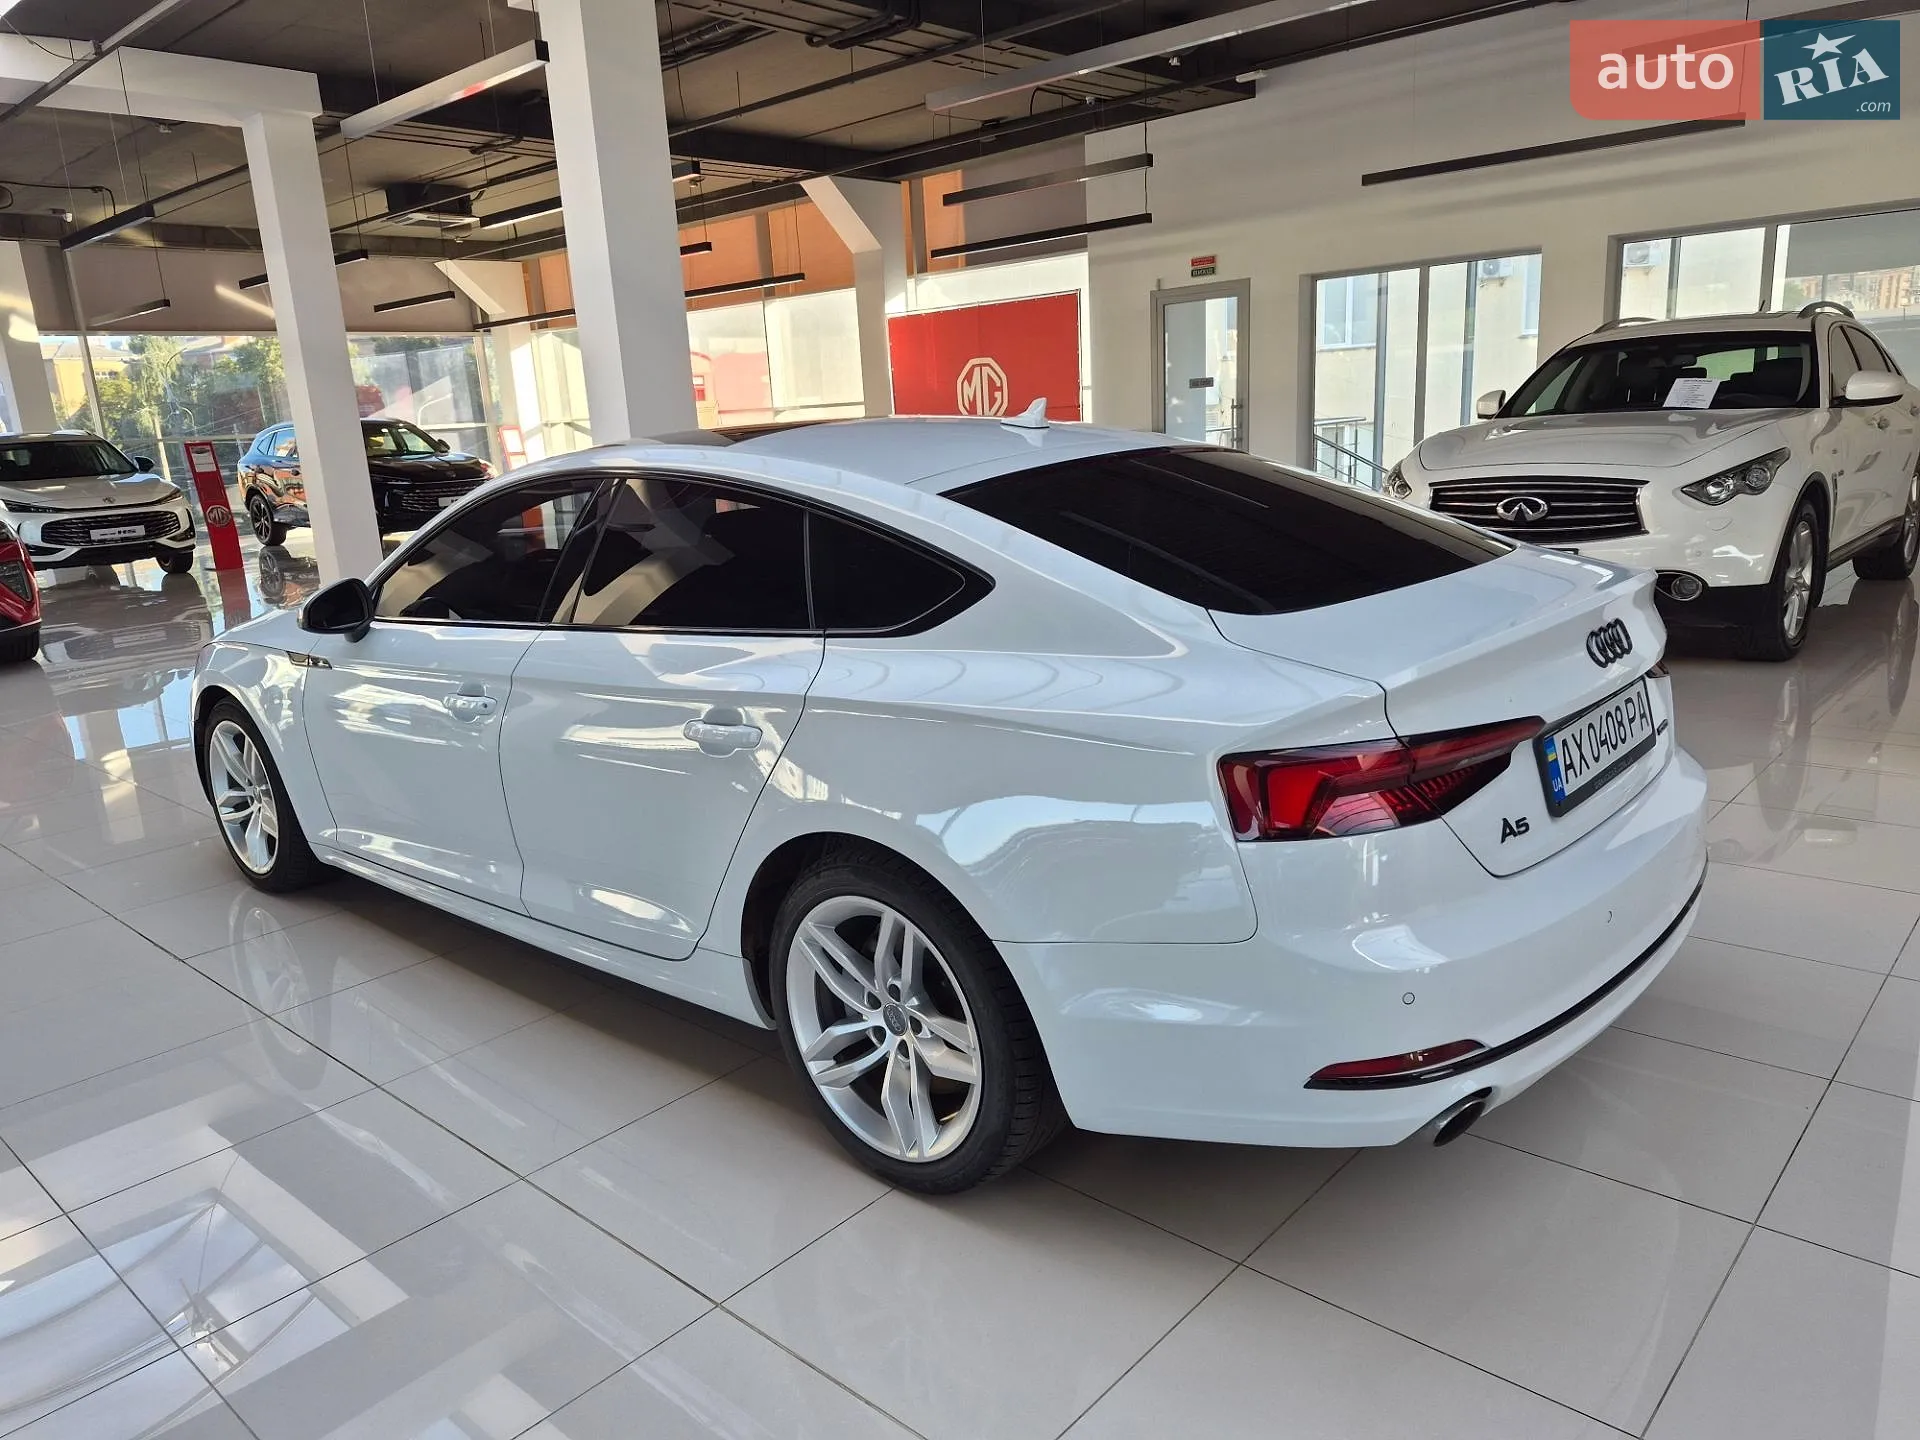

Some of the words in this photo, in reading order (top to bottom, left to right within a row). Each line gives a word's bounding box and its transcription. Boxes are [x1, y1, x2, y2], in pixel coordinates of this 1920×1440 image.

[961, 365, 1003, 417] MG
[1552, 777, 1563, 792] UA
[1500, 816, 1530, 844] A5
